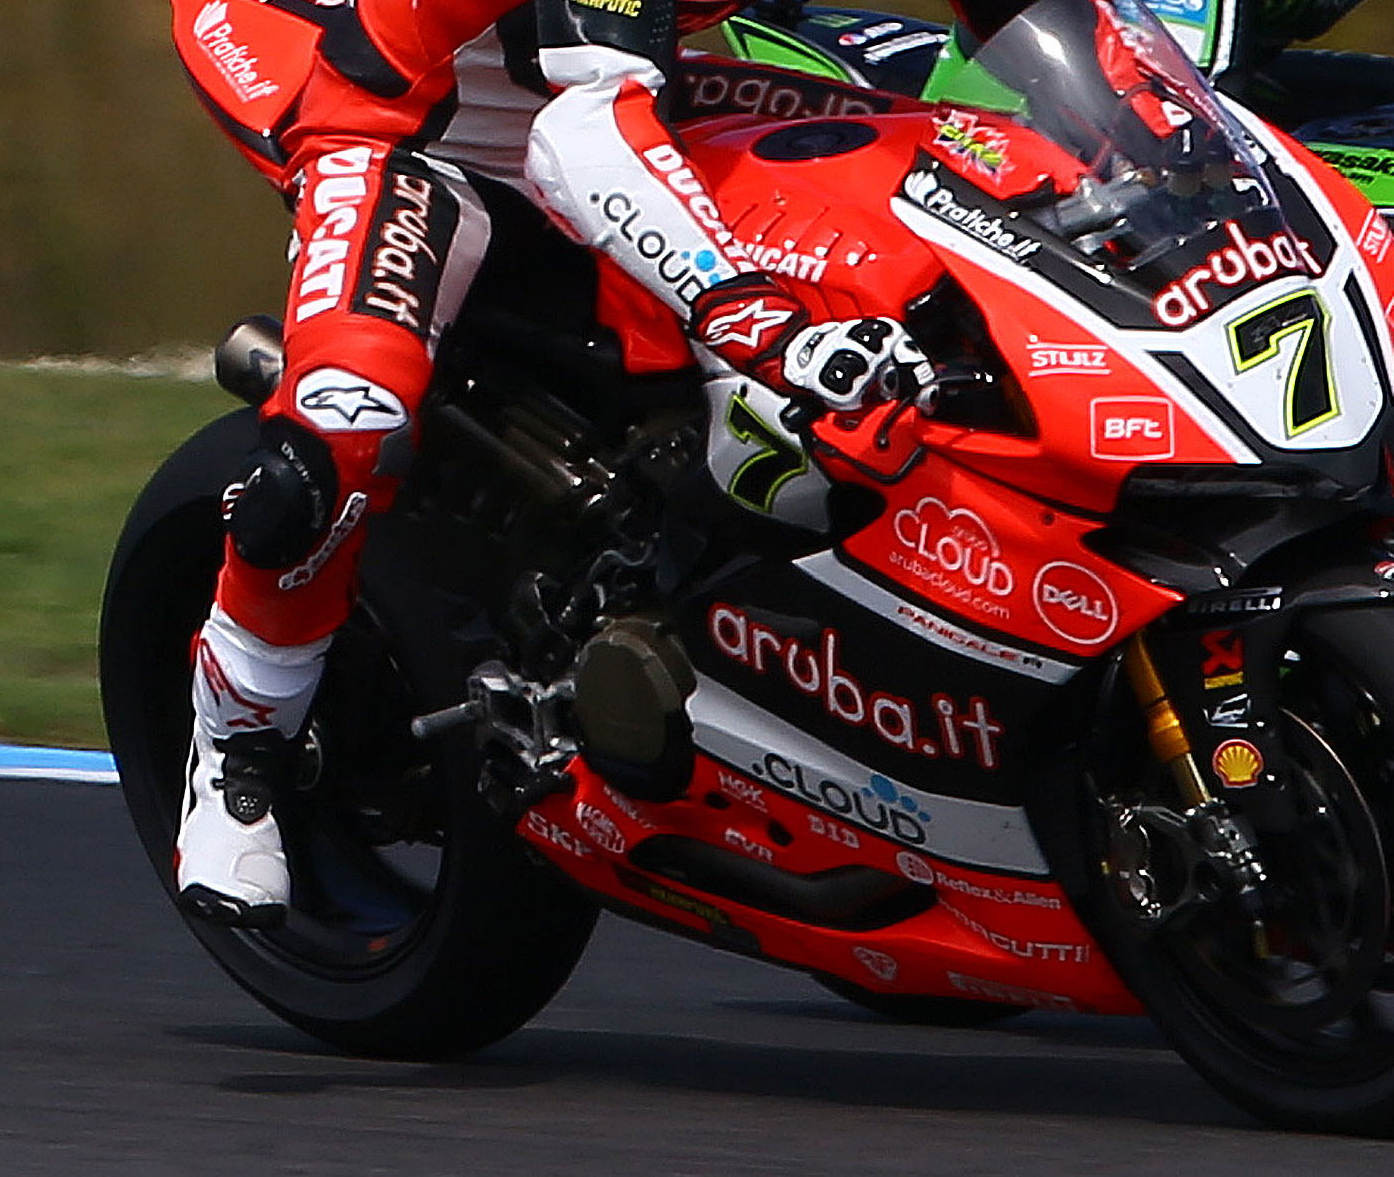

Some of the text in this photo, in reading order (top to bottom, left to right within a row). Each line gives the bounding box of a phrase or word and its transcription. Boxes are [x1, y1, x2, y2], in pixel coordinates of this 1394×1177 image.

[297, 145, 373, 323] DUCATI
[1032, 350, 1106, 367] STULZ
[1224, 287, 1342, 440] 7
[725, 392, 807, 514] 7
[1042, 583, 1108, 621] DELL
[713, 607, 1001, 769] aruba.it
[752, 752, 926, 845] .CLOUD
